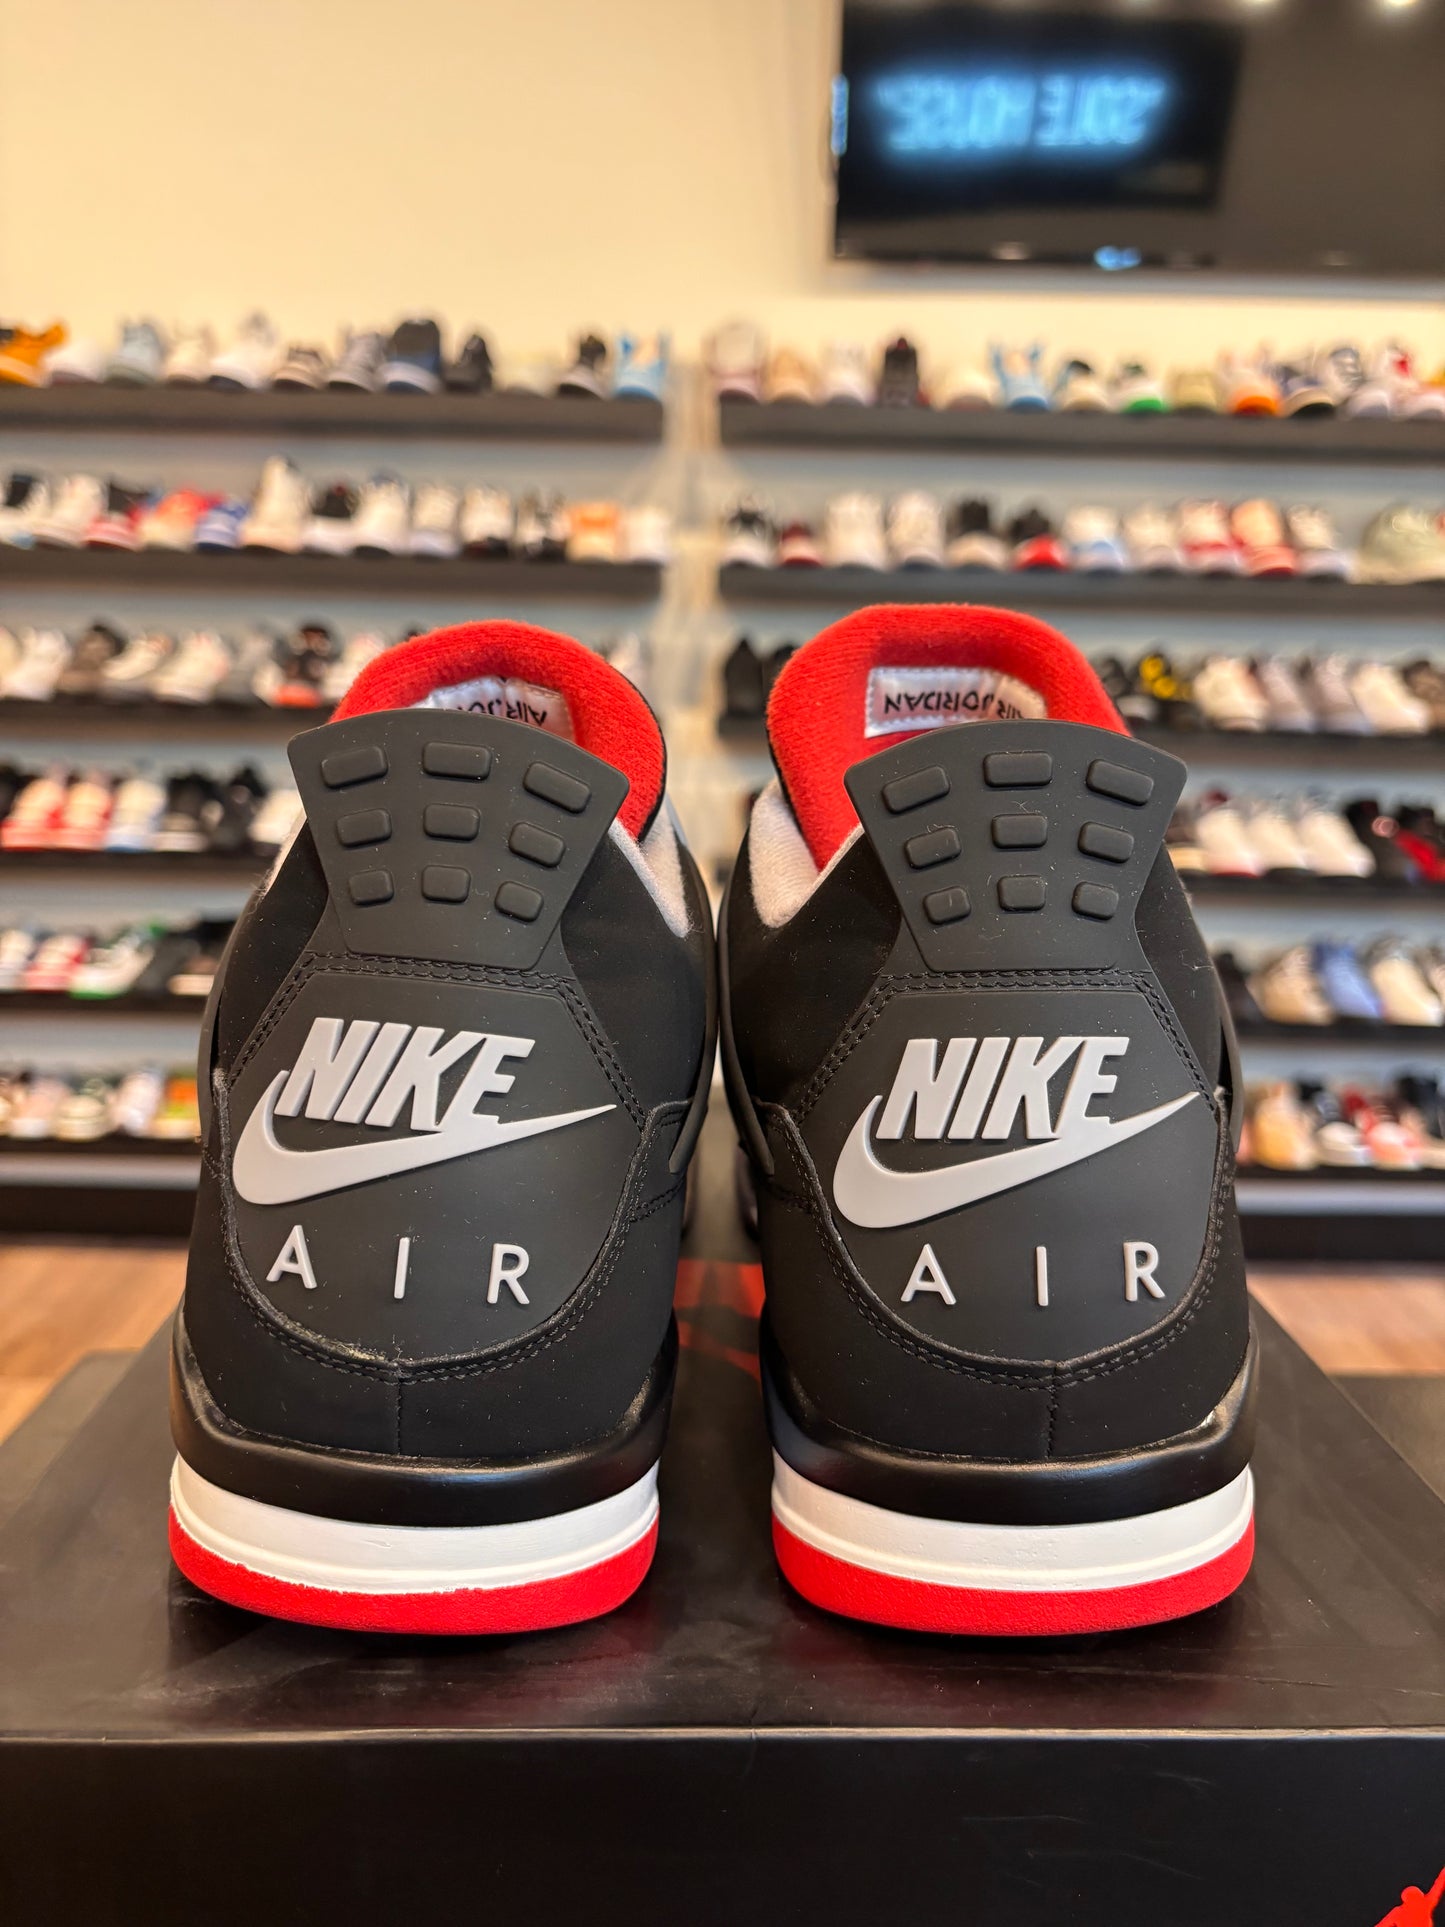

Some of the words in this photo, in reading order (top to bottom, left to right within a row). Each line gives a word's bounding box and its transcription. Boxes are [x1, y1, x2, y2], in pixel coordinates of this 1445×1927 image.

[884, 690, 995, 714] JORDAN
[274, 1016, 536, 1131] NIKE
[875, 1036, 1130, 1140] NIKE
[266, 1225, 530, 1305] AIR
[901, 1241, 1166, 1307] AIR
